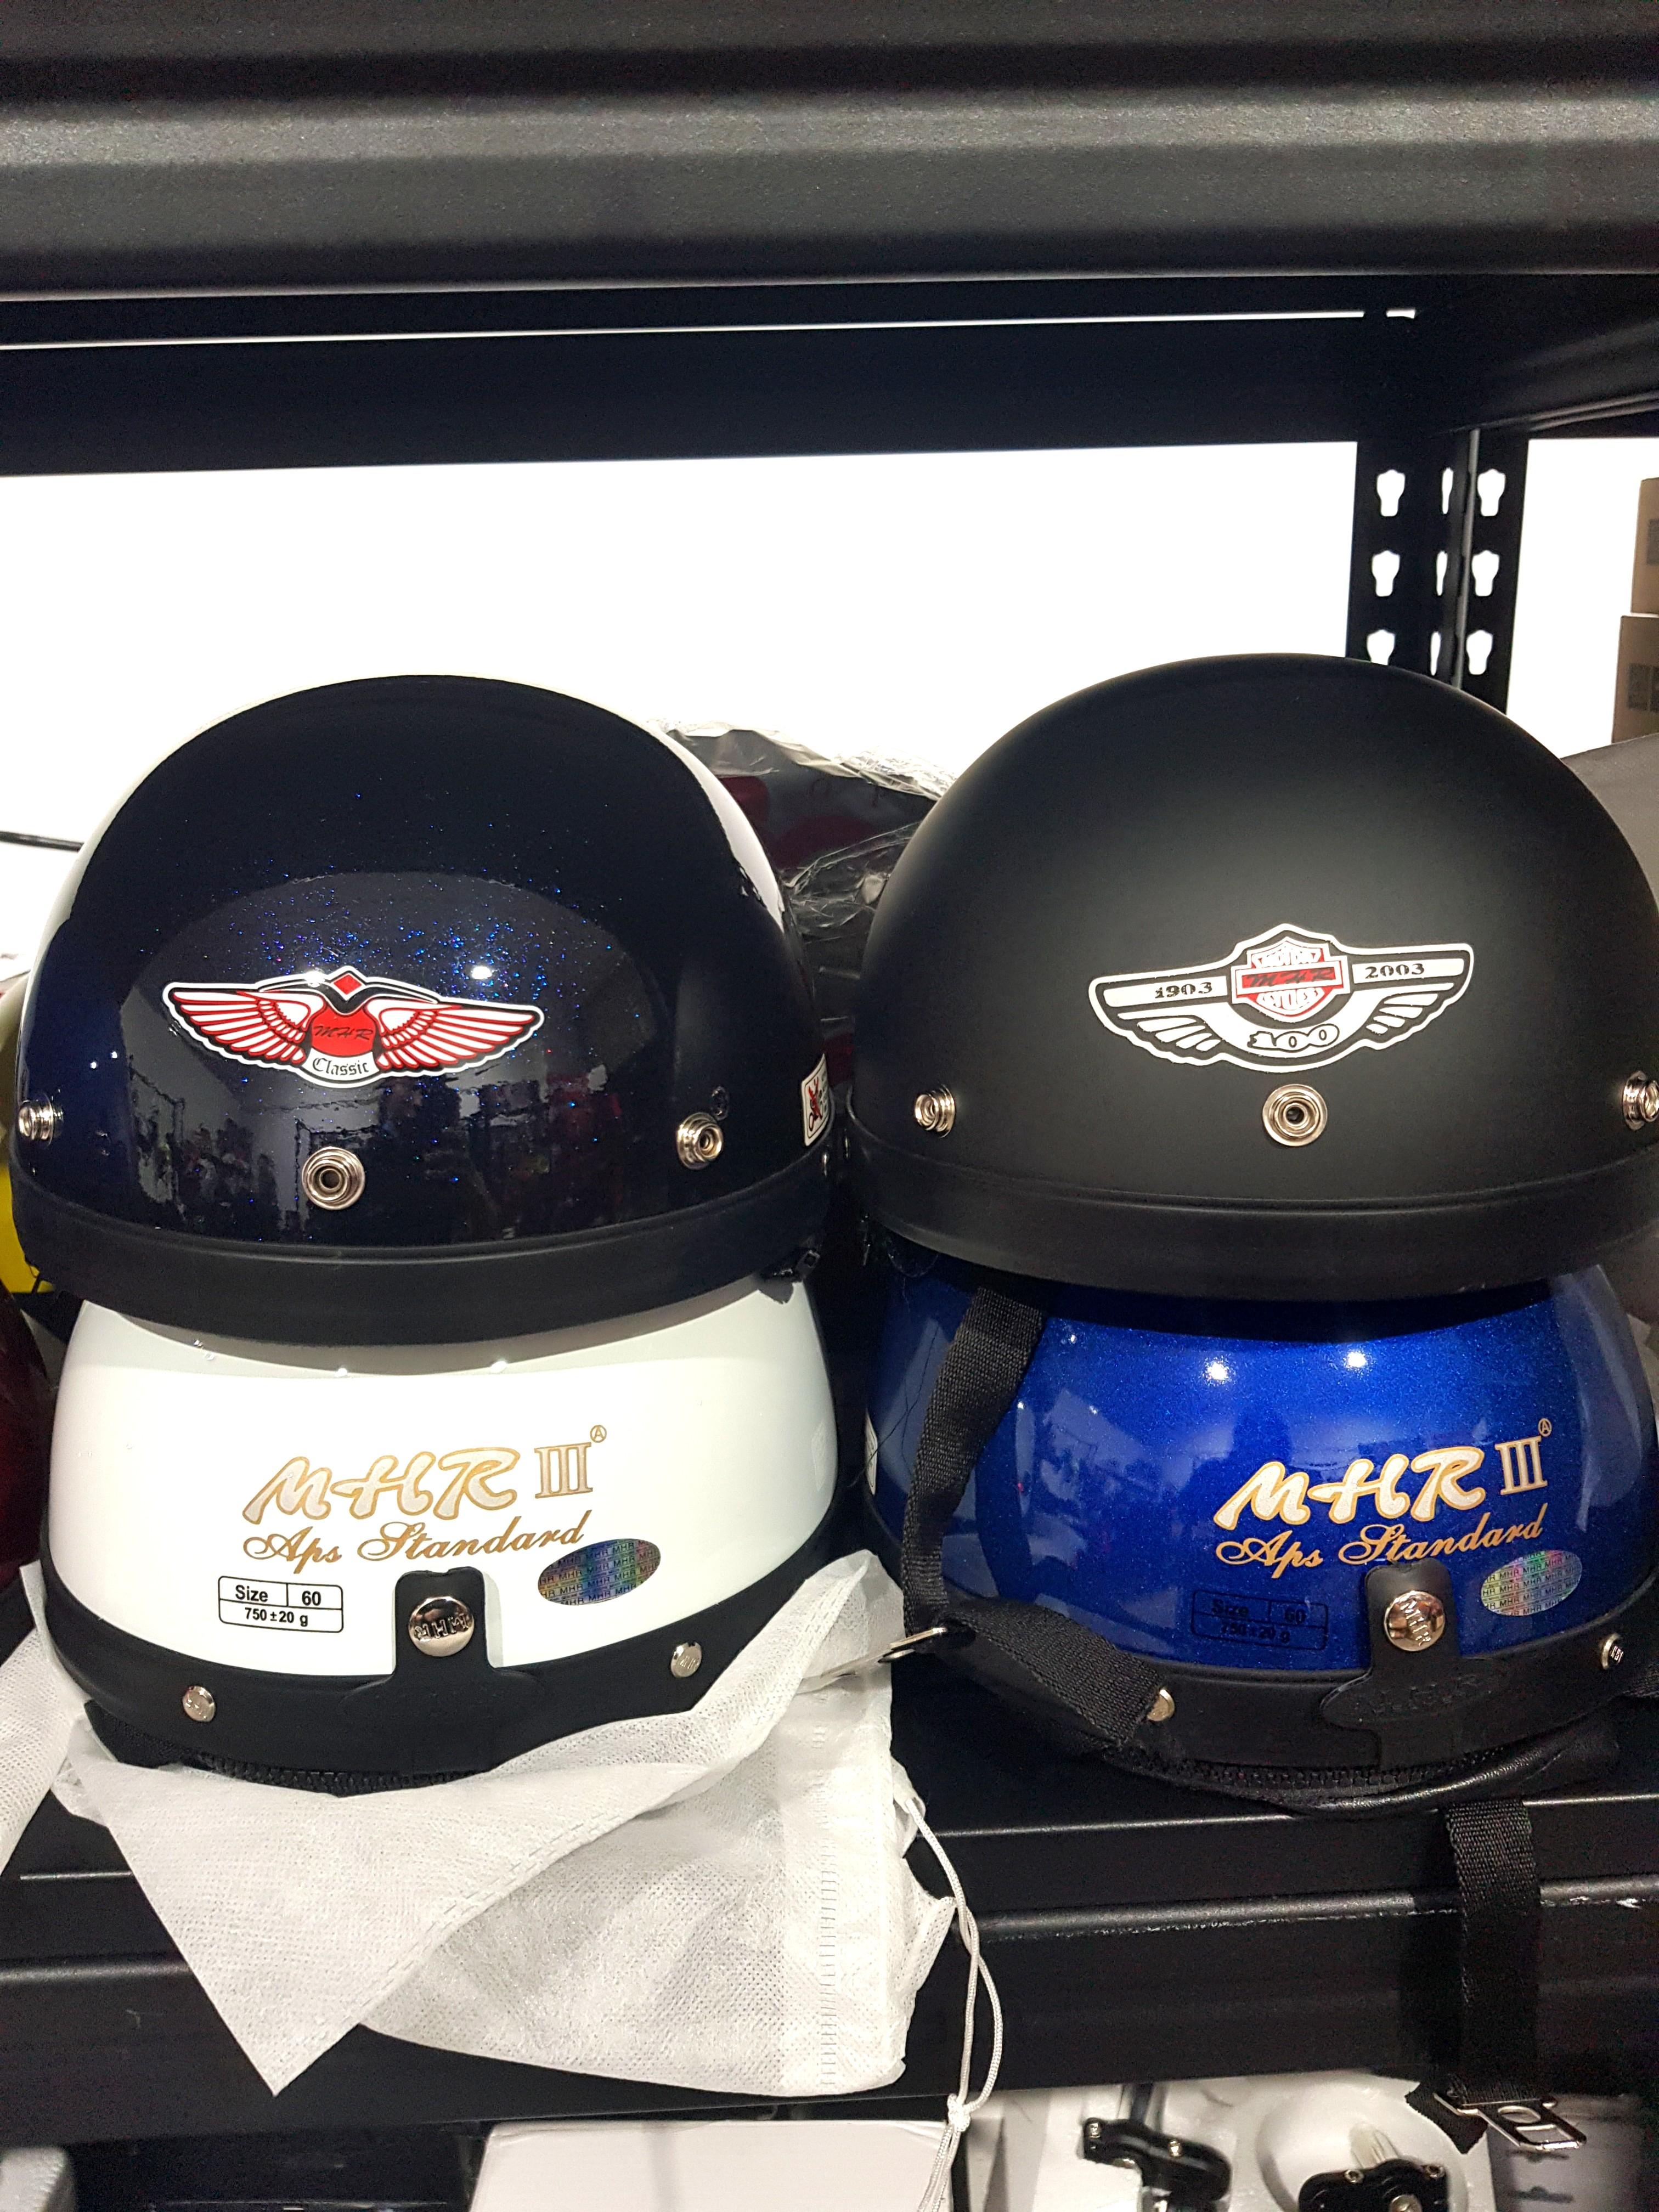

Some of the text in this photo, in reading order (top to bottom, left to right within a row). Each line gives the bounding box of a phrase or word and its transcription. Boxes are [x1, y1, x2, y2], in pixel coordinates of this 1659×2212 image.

[1365, 963, 1425, 979] 2003
[1155, 983, 1212, 999] 1903
[313, 1025, 373, 1040] MHR
[312, 1058, 369, 1075] Classic
[242, 1447, 520, 1524] MHR
[1213, 1446, 1486, 1530] MHR
[243, 1510, 592, 1574] Aps Standard
[612, 1542, 634, 1553] MHR
[1216, 1503, 1548, 1578] Aps Standard
[559, 1571, 582, 1580] MHR
[587, 1564, 609, 1573] MHR
[613, 1556, 635, 1566] MHR
[1500, 1570, 1519, 1579] MHR
[1523, 1564, 1541, 1573] MHR
[560, 1583, 583, 1594] MHR
[588, 1577, 610, 1587] MHR
[614, 1570, 635, 1580] MHR
[1500, 1584, 1519, 1593] MHR
[1523, 1578, 1541, 1587] MHR
[235, 1584, 268, 1602] Size
[301, 1590, 321, 1606] 60
[589, 1592, 611, 1602] MHR
[1500, 1598, 1519, 1606] MHR
